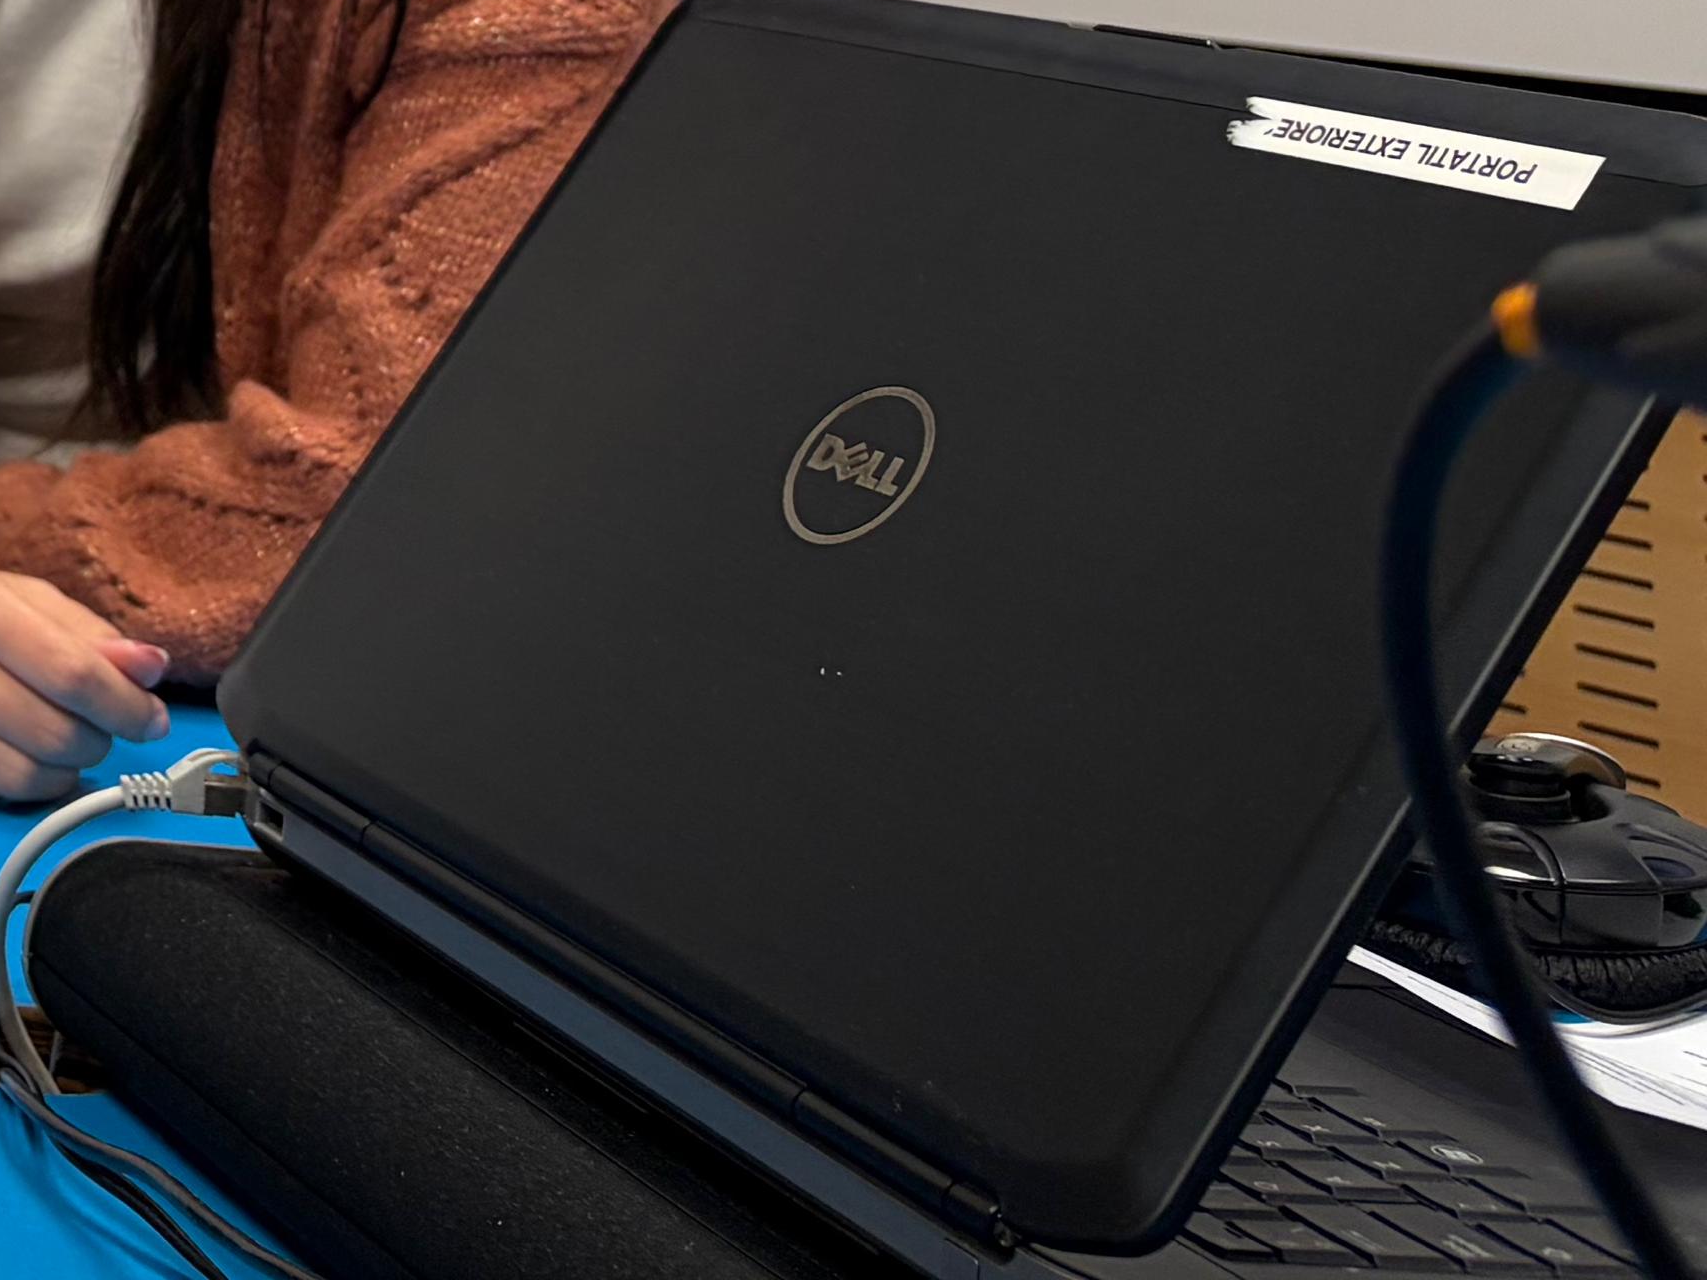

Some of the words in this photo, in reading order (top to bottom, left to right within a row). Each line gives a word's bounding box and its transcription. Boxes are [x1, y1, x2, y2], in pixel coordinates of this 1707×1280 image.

[1263, 118, 1411, 161] EXTERIORE
[1417, 143, 1538, 184] PORTATIL
[806, 433, 905, 496] DELL
